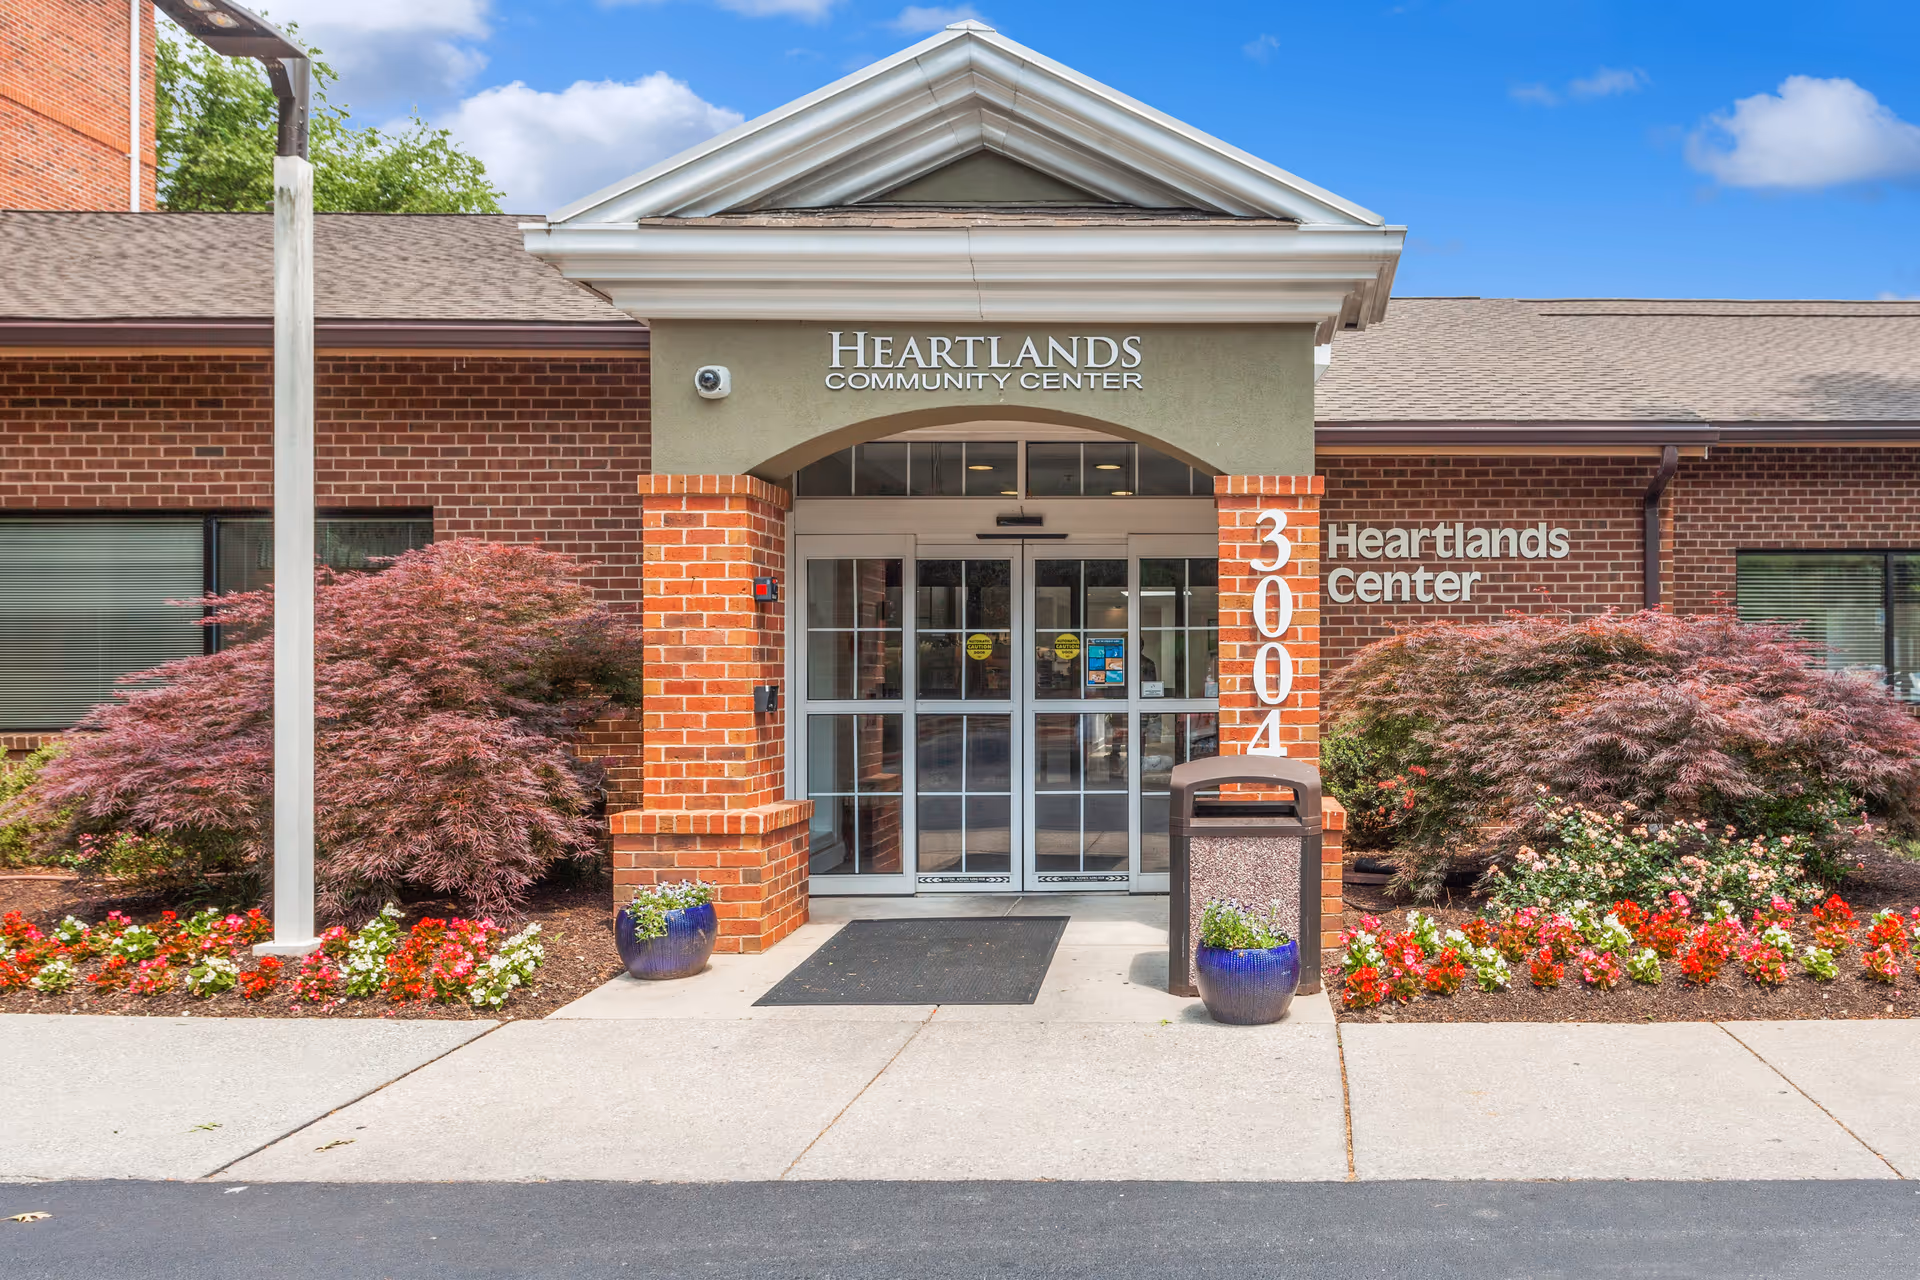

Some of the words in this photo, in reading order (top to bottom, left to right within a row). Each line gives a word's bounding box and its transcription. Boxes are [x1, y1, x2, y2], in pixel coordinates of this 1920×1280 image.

[828, 331, 1142, 369] HEARTLANDS
[825, 372, 1012, 390] COMMUNITY
[1020, 372, 1144, 390] CENTER
[1328, 522, 1570, 559] Heartlands
[1327, 566, 1482, 603] Center
[1246, 509, 1293, 757] 3004
